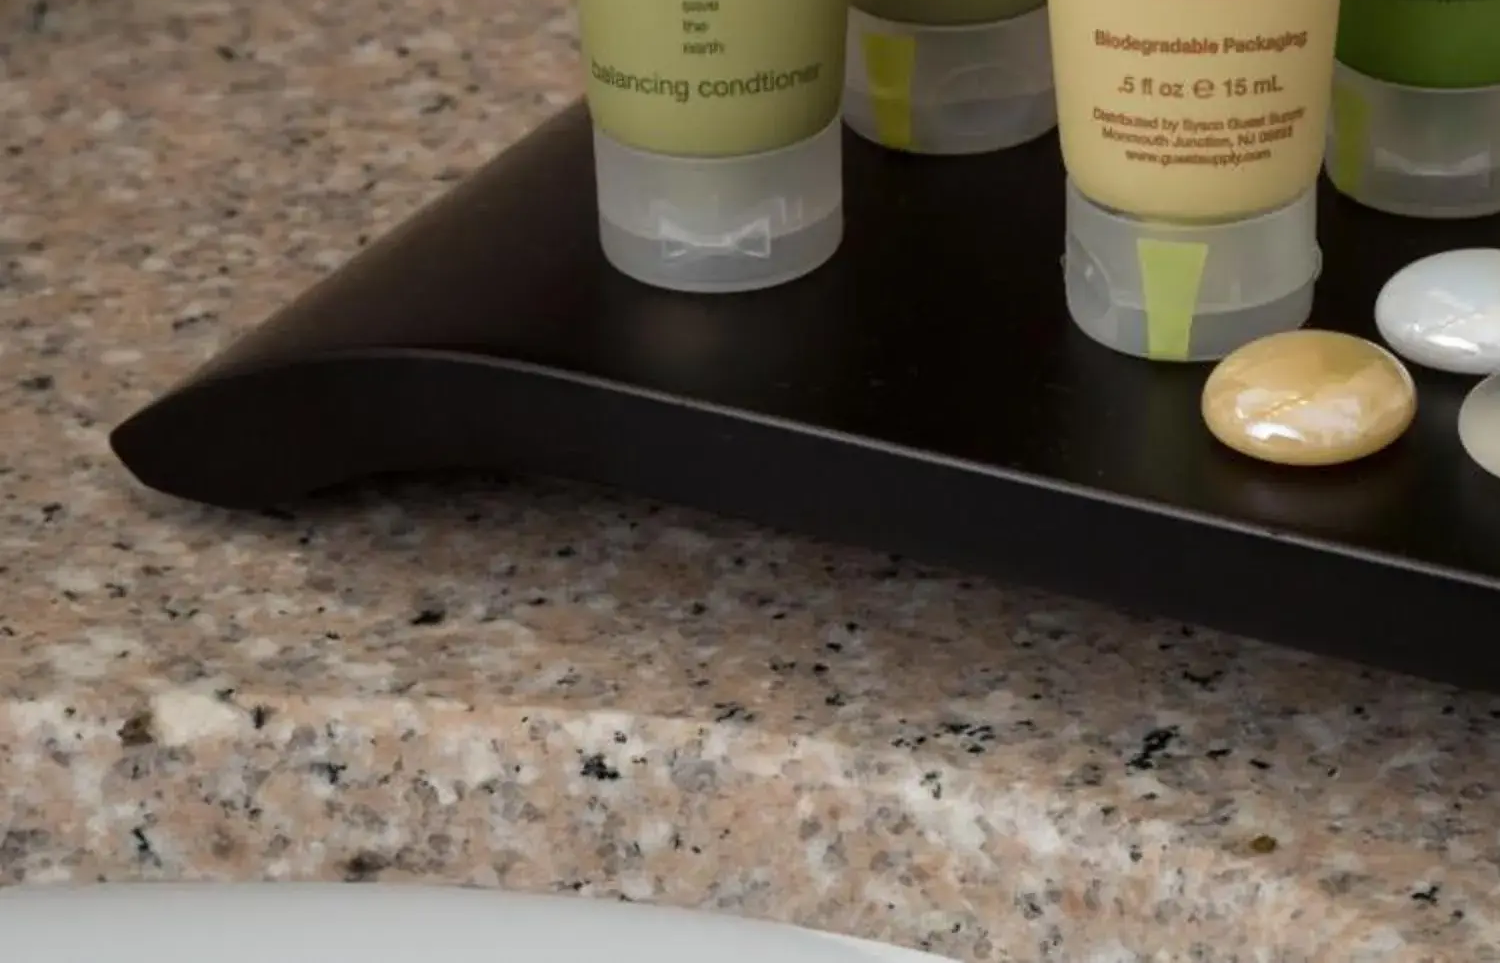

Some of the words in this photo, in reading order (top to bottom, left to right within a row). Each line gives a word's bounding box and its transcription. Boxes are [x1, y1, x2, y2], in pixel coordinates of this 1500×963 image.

[1094, 28, 1219, 56] Biodegradable
[1223, 30, 1308, 54] Packaging
[591, 57, 690, 104] balancing
[1117, 76, 1135, 94] .5
[1141, 77, 1153, 96] fl
[1159, 82, 1184, 97] oz
[1223, 78, 1248, 97] 15
